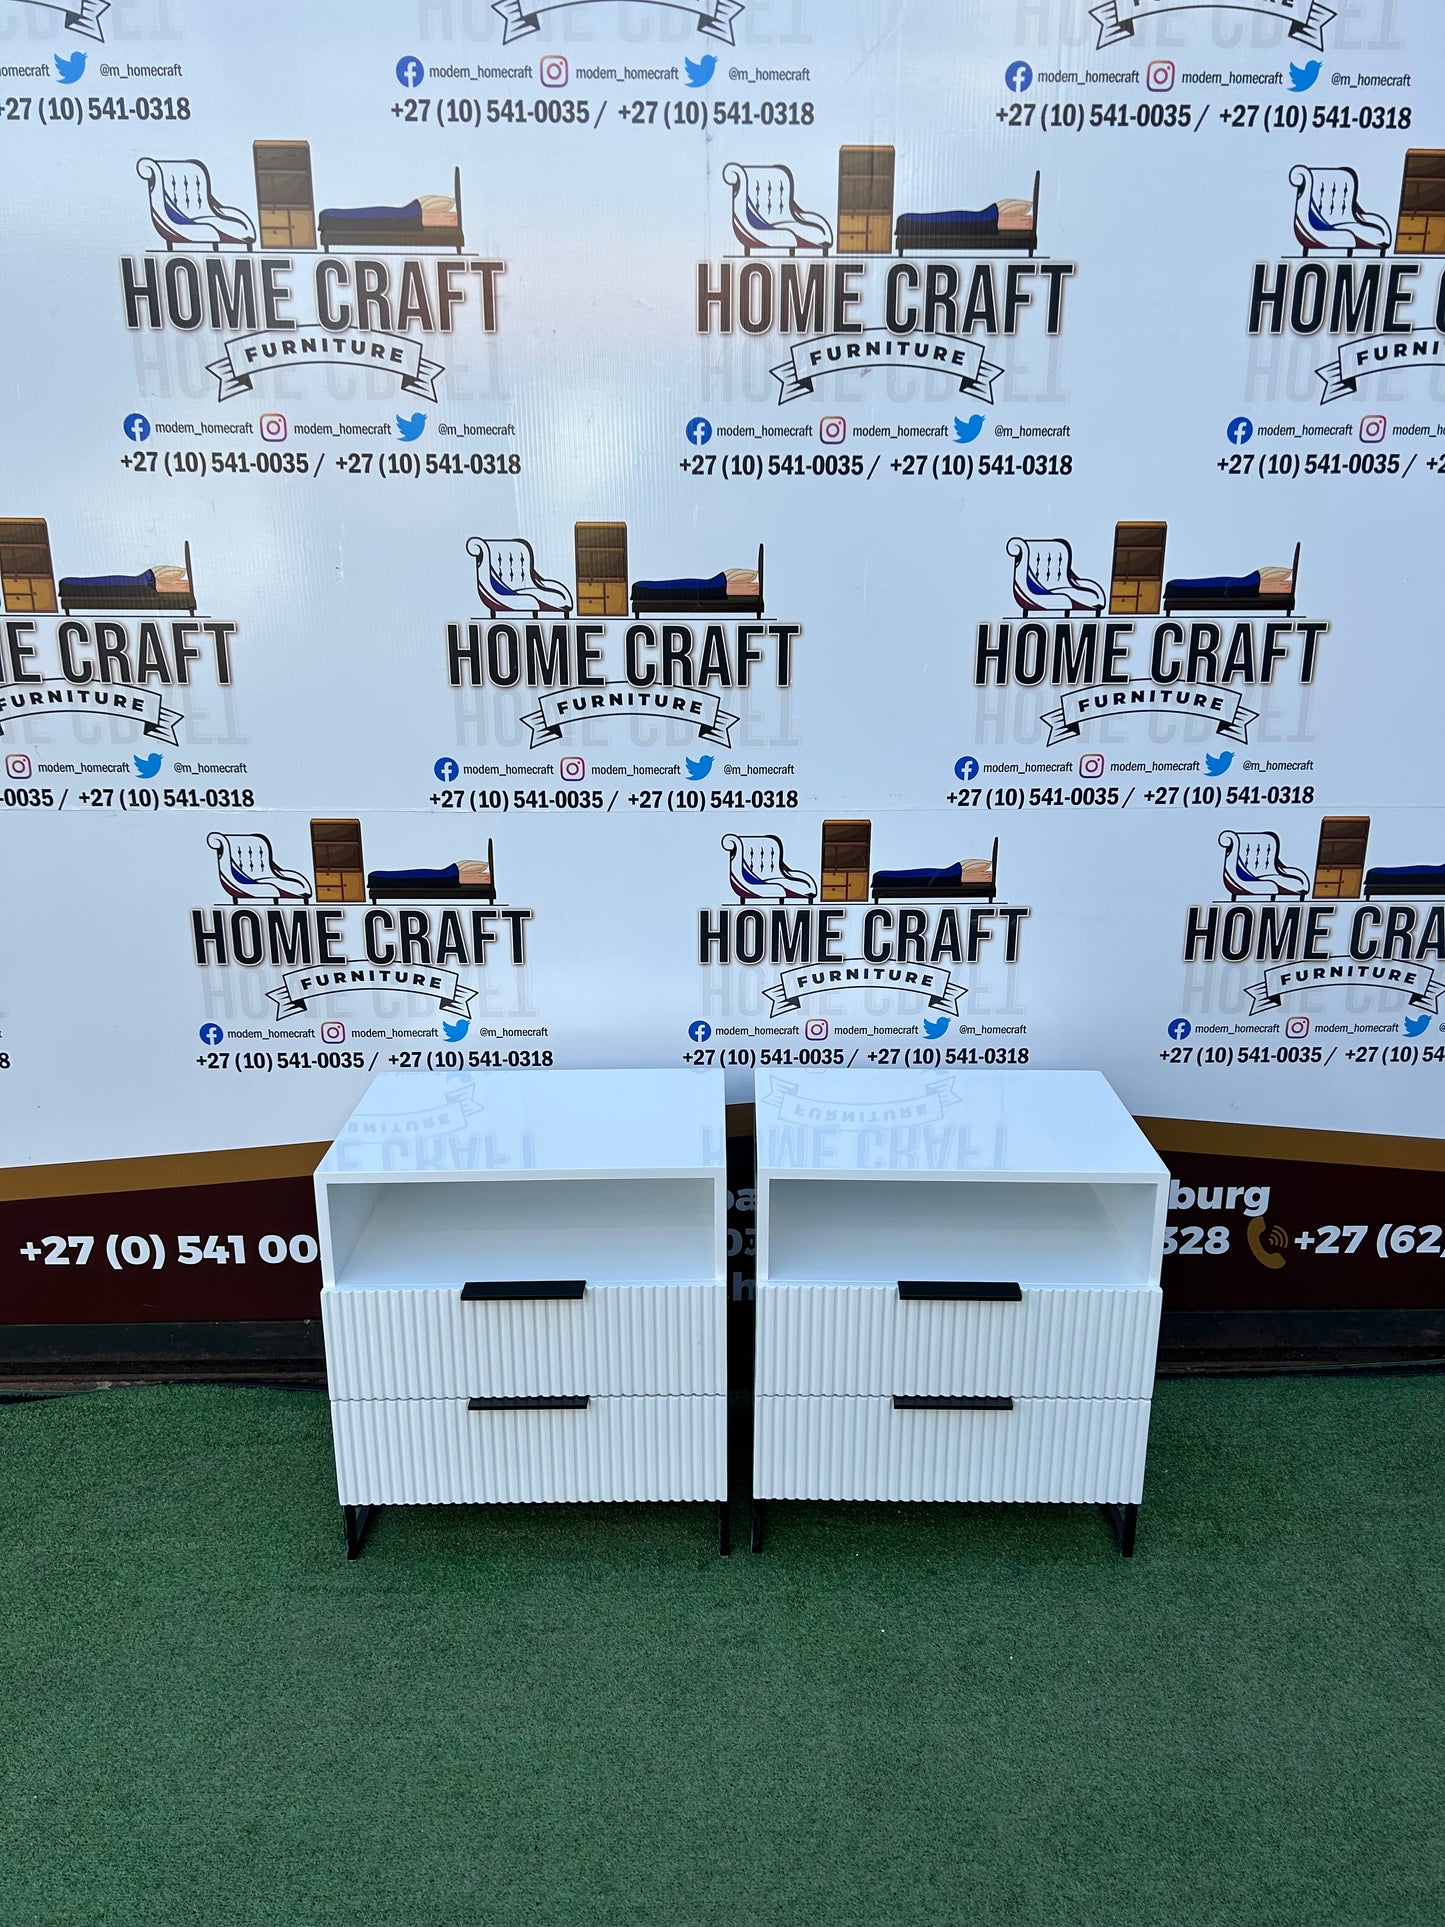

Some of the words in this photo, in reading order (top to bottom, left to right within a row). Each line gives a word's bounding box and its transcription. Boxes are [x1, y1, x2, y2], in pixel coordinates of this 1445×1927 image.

[0, 64, 50, 77] omecraft
[100, 63, 183, 79] @m_homecraft
[729, 67, 810, 83] @m_homecraft
[1331, 72, 1411, 88] @m_homecraft
[39, 97, 83, 125] (10)
[88, 97, 191, 120] 541-0318
[391, 98, 431, 122] +27
[437, 99, 481, 128] (10)
[487, 99, 589, 124] 541-0035
[594, 100, 607, 129] /
[618, 100, 658, 124] +27
[664, 101, 708, 130] (10)
[713, 101, 814, 125] 541-0318
[996, 103, 1036, 126] +27
[1041, 103, 1084, 132] (10)
[1090, 104, 1191, 127] 541-0035
[1194, 104, 1210, 132] /
[1220, 104, 1259, 127] +27
[1264, 105, 1307, 133] (10)
[1312, 106, 1412, 129] 541-0318
[121, 258, 295, 332] HOME
[316, 259, 504, 334] CRAFT
[698, 263, 863, 336] HOME
[886, 264, 1073, 337] CRAFT
[1249, 263, 1419, 336] HOME
[244, 338, 403, 364] FURNITURE
[810, 341, 965, 366] FURNITURE
[1357, 341, 1439, 366] FURNI
[438, 423, 515, 437] @m_homecraft
[995, 425, 1070, 439] @m_homecraft
[120, 451, 158, 472] +27
[164, 452, 206, 477] (10)
[212, 452, 309, 473] 541-0035
[313, 453, 325, 478] /
[336, 453, 373, 473] +27
[379, 453, 420, 479] (10)
[426, 453, 521, 474] 541-0318
[679, 455, 717, 475] +27
[722, 455, 763, 480] (10)
[768, 455, 863, 475] 541-0035
[867, 455, 881, 480] /
[890, 455, 928, 475] +27
[933, 455, 973, 480] (10)
[978, 455, 1072, 475] 541-0318
[1217, 454, 1255, 474] +27
[1259, 454, 1300, 479] (10)
[1304, 454, 1400, 474] 541-0035
[1401, 454, 1418, 478] /
[58, 622, 234, 686] CRAFT
[448, 624, 604, 689] HOME
[626, 625, 799, 689] CRAFT
[976, 624, 1132, 687] HOME
[1151, 623, 1327, 686] CRAFT
[557, 693, 702, 715] FURNITURE
[1078, 690, 1224, 712] FURNITURE
[174, 762, 247, 775] @m_homecraft
[724, 764, 794, 776] @m_homecraft
[1243, 760, 1314, 772] @m_homecraft
[58, 789, 69, 811] /
[79, 789, 114, 807] +27
[120, 789, 159, 811] (10)
[164, 789, 254, 807] 541-0318
[430, 790, 464, 808] +27
[470, 790, 509, 812] (10)
[514, 790, 603, 808] 541-0035
[607, 791, 619, 812] /
[628, 790, 662, 808] +27
[668, 790, 705, 812] (10)
[710, 790, 798, 808] 541-0318
[947, 789, 982, 806] +27
[986, 788, 1024, 810] (10)
[1029, 787, 1119, 806] 541-0035
[1121, 787, 1135, 808] /
[1144, 787, 1179, 804] +27
[1183, 786, 1221, 808] (10)
[1226, 786, 1314, 804] 541-0318
[192, 910, 345, 967] HOME
[365, 910, 531, 967] CRAFT
[700, 910, 844, 966] HOME
[864, 909, 1028, 965] CRAFT
[1185, 907, 1334, 963] HOME
[300, 970, 441, 990] FURNITURE
[797, 968, 933, 988] FURNITURE
[1280, 966, 1417, 986] FURNITURE
[480, 1027, 548, 1038] @m_homecraft
[959, 1025, 1027, 1036] @m_homecraft
[196, 1053, 230, 1069] +27
[235, 1052, 273, 1072] (10)
[277, 1052, 364, 1069] 541-0035
[368, 1052, 379, 1071] /
[388, 1052, 422, 1067] +27
[427, 1051, 464, 1071] (10)
[469, 1050, 553, 1067] 541-0318
[683, 1049, 715, 1065] +27
[720, 1049, 756, 1069] (10)
[760, 1049, 844, 1065] 541-0035
[847, 1049, 859, 1068] /
[867, 1048, 900, 1064] +27
[905, 1048, 941, 1068] (10)
[945, 1048, 1029, 1064] 541-0318
[1160, 1047, 1193, 1063] +27
[1197, 1047, 1233, 1067] (10)
[1237, 1047, 1322, 1063] 541-0035
[1323, 1047, 1338, 1066] /
[1345, 1046, 1379, 1062] +27
[1382, 1046, 1418, 1066] (10)
[1168, 1179, 1271, 1217] burg
[1294, 1225, 1369, 1254] +27
[20, 1236, 95, 1265] +27
[106, 1234, 166, 1270] (0)
[177, 1235, 246, 1264] 541
[258, 1234, 322, 1264] 00
